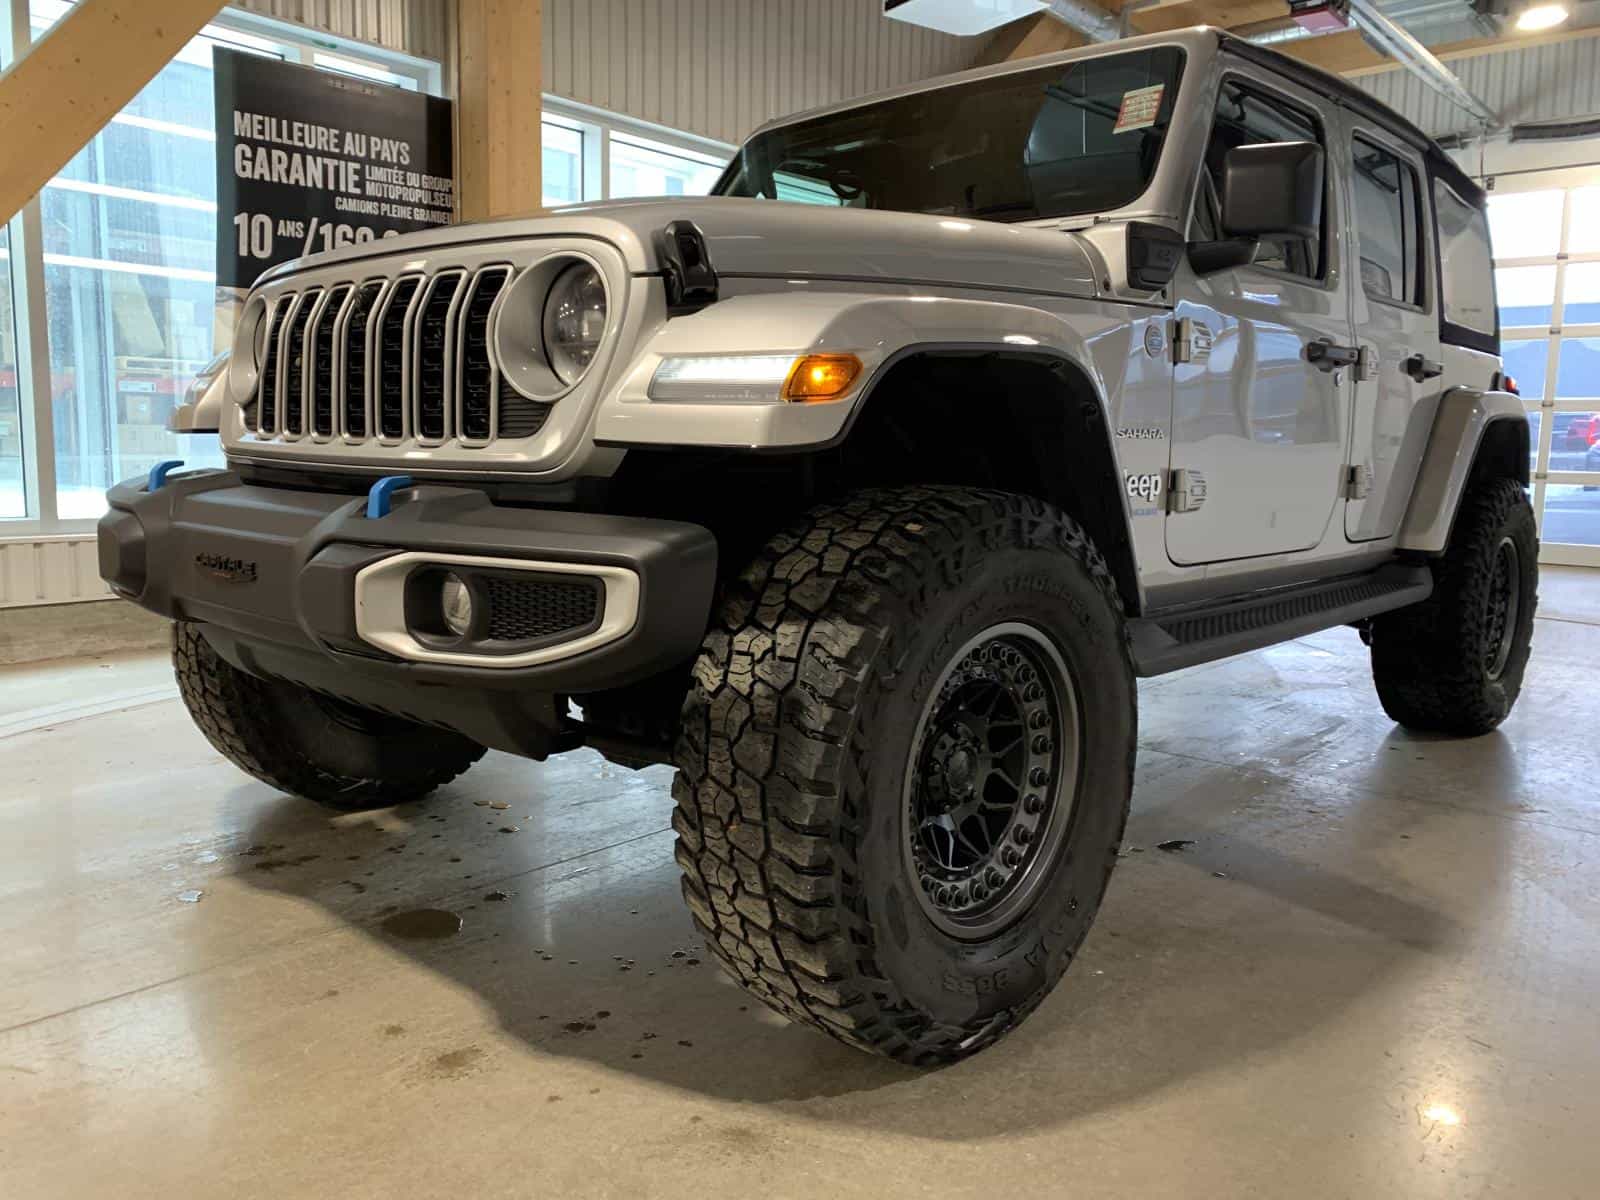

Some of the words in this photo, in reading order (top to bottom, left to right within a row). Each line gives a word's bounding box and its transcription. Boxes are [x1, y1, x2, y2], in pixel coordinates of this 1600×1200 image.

[233, 110, 341, 153] MEILLEURE
[343, 131, 367, 158] AU
[369, 136, 411, 166] PAYS
[233, 143, 362, 195] GARANTIE
[364, 165, 406, 187] LIMITÉE
[406, 173, 421, 188] DU
[421, 175, 452, 193] GROUP
[364, 181, 452, 208] MOTOPROPULSEU
[334, 196, 380, 216] CAMIONS
[381, 201, 413, 221] PLEINE
[413, 206, 452, 226] GRANDE
[233, 212, 273, 259] 10
[277, 218, 305, 239] ANS
[1115, 428, 1164, 440] SAHARA
